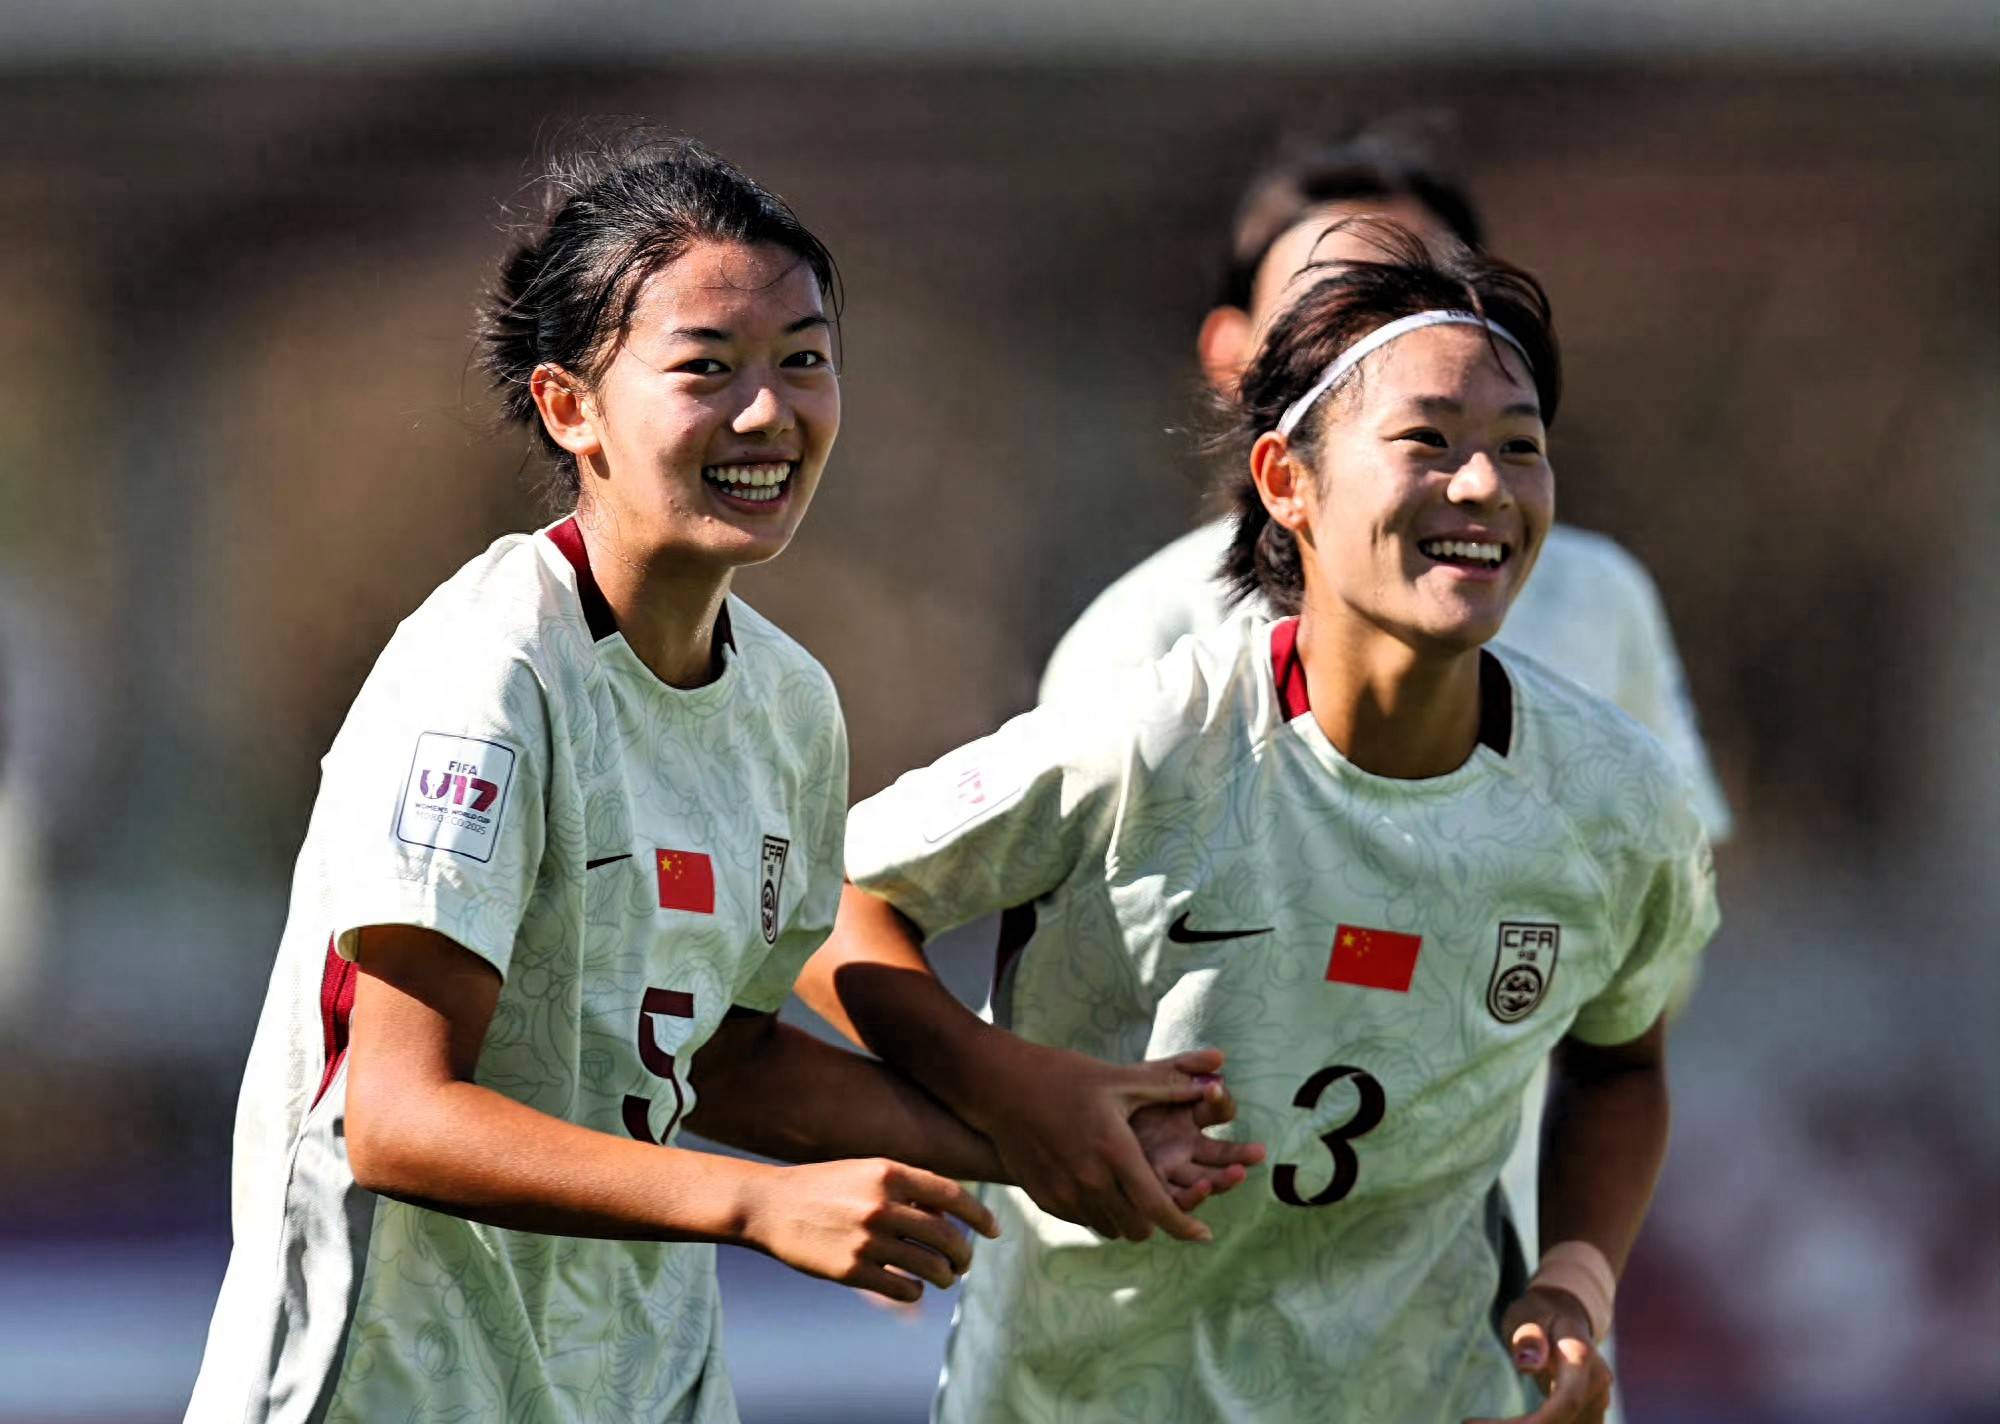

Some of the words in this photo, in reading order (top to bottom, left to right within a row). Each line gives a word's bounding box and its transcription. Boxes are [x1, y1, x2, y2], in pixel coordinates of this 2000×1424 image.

[449, 761, 478, 776] FIFA
[420, 769, 498, 813] U17
[451, 810, 477, 820] WORLD
[477, 816, 491, 824] CUP
[464, 821, 487, 835] 2025
[763, 843, 784, 864] CFA
[1504, 930, 1553, 948] CFA
[622, 987, 695, 1145] 5
[1272, 1065, 1386, 1207] 3
